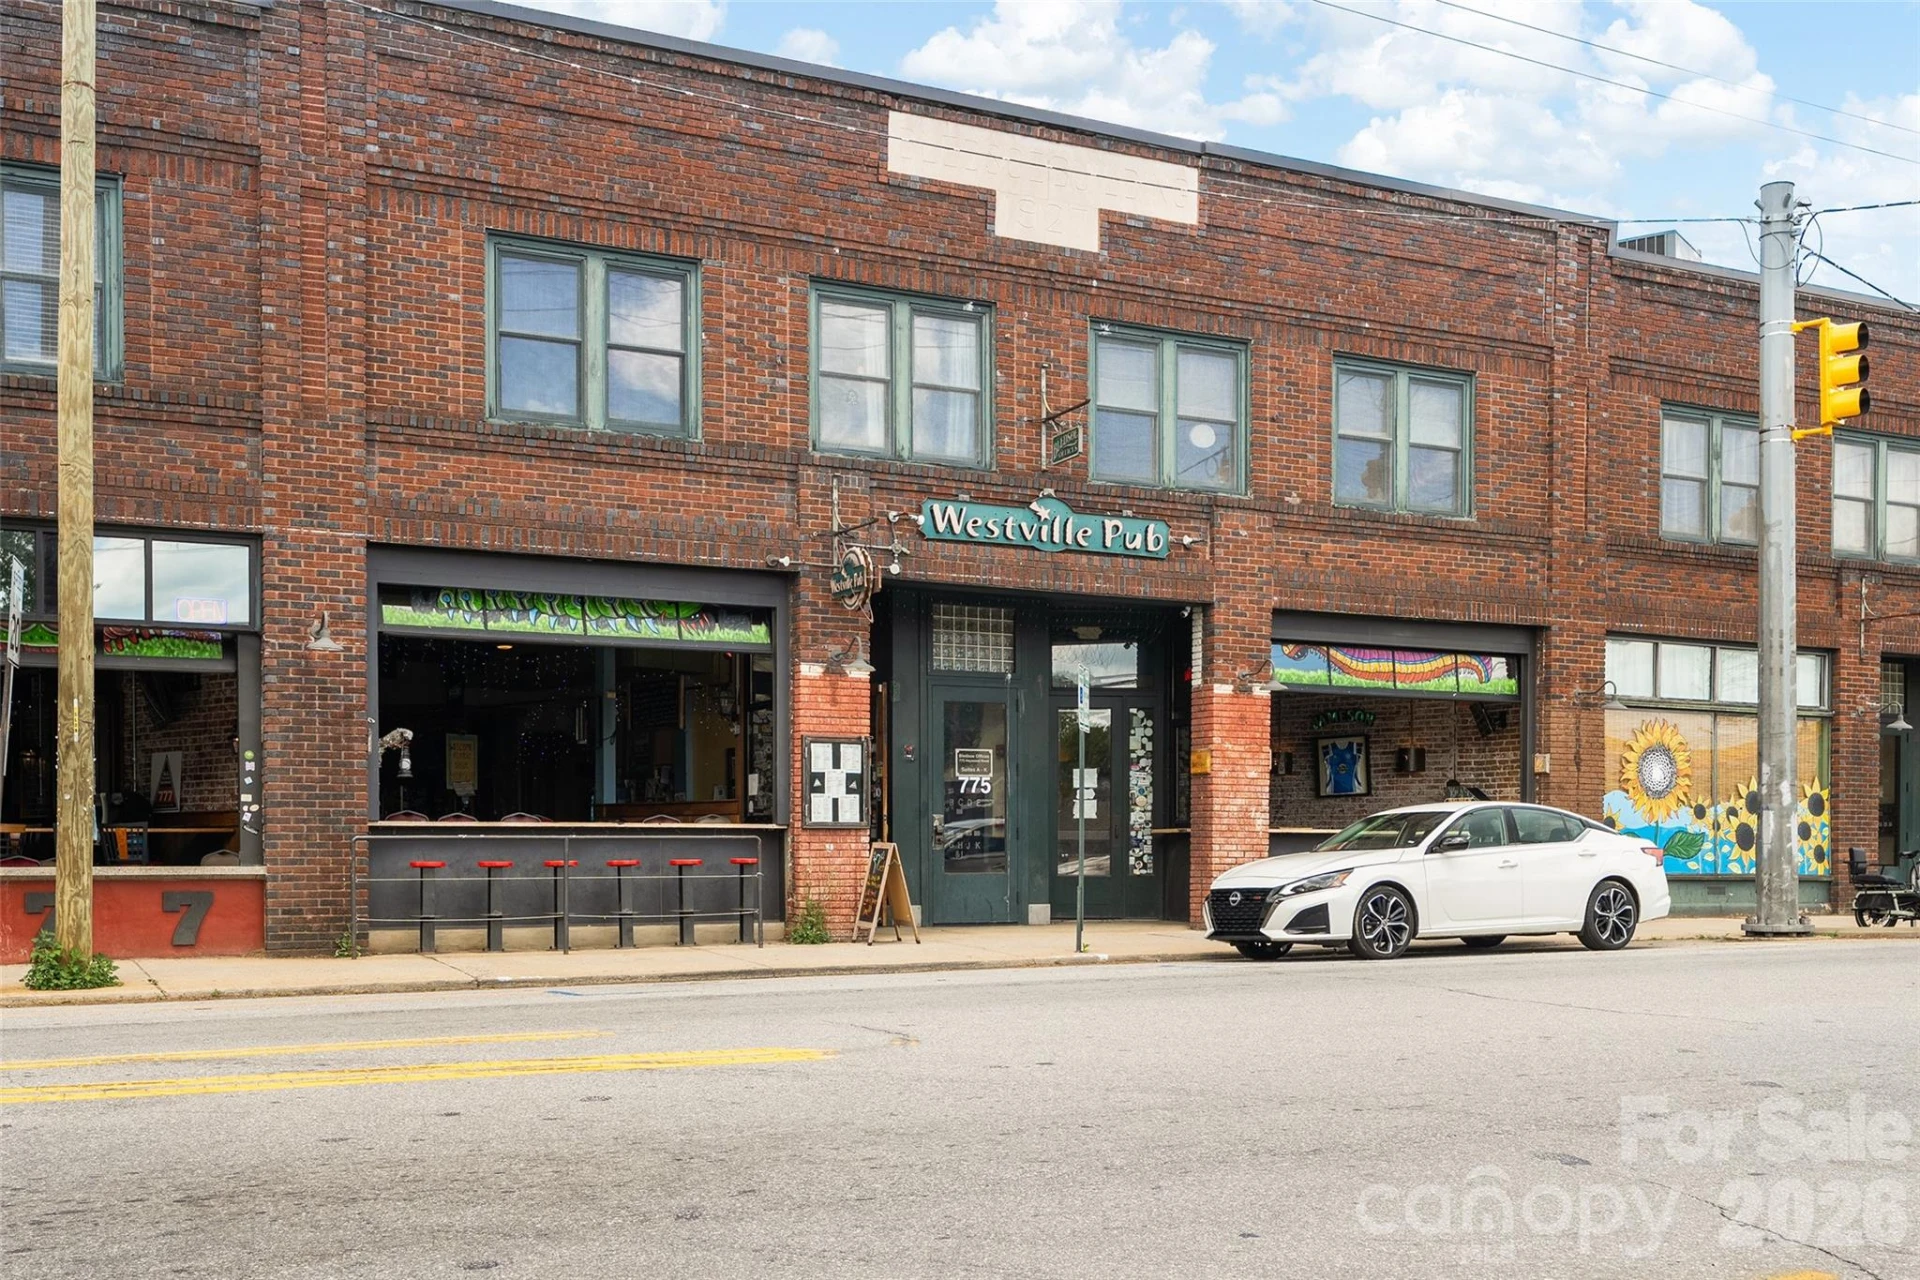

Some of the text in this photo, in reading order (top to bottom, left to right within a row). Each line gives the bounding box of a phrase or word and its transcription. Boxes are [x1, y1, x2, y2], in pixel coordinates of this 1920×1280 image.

[1048, 155, 1189, 208] BULDNG
[931, 503, 1164, 552] Westville Pub
[177, 599, 226, 622] OPEN
[1312, 709, 1377, 730] JAMESON
[957, 776, 992, 794] 775
[161, 891, 214, 947] 7
